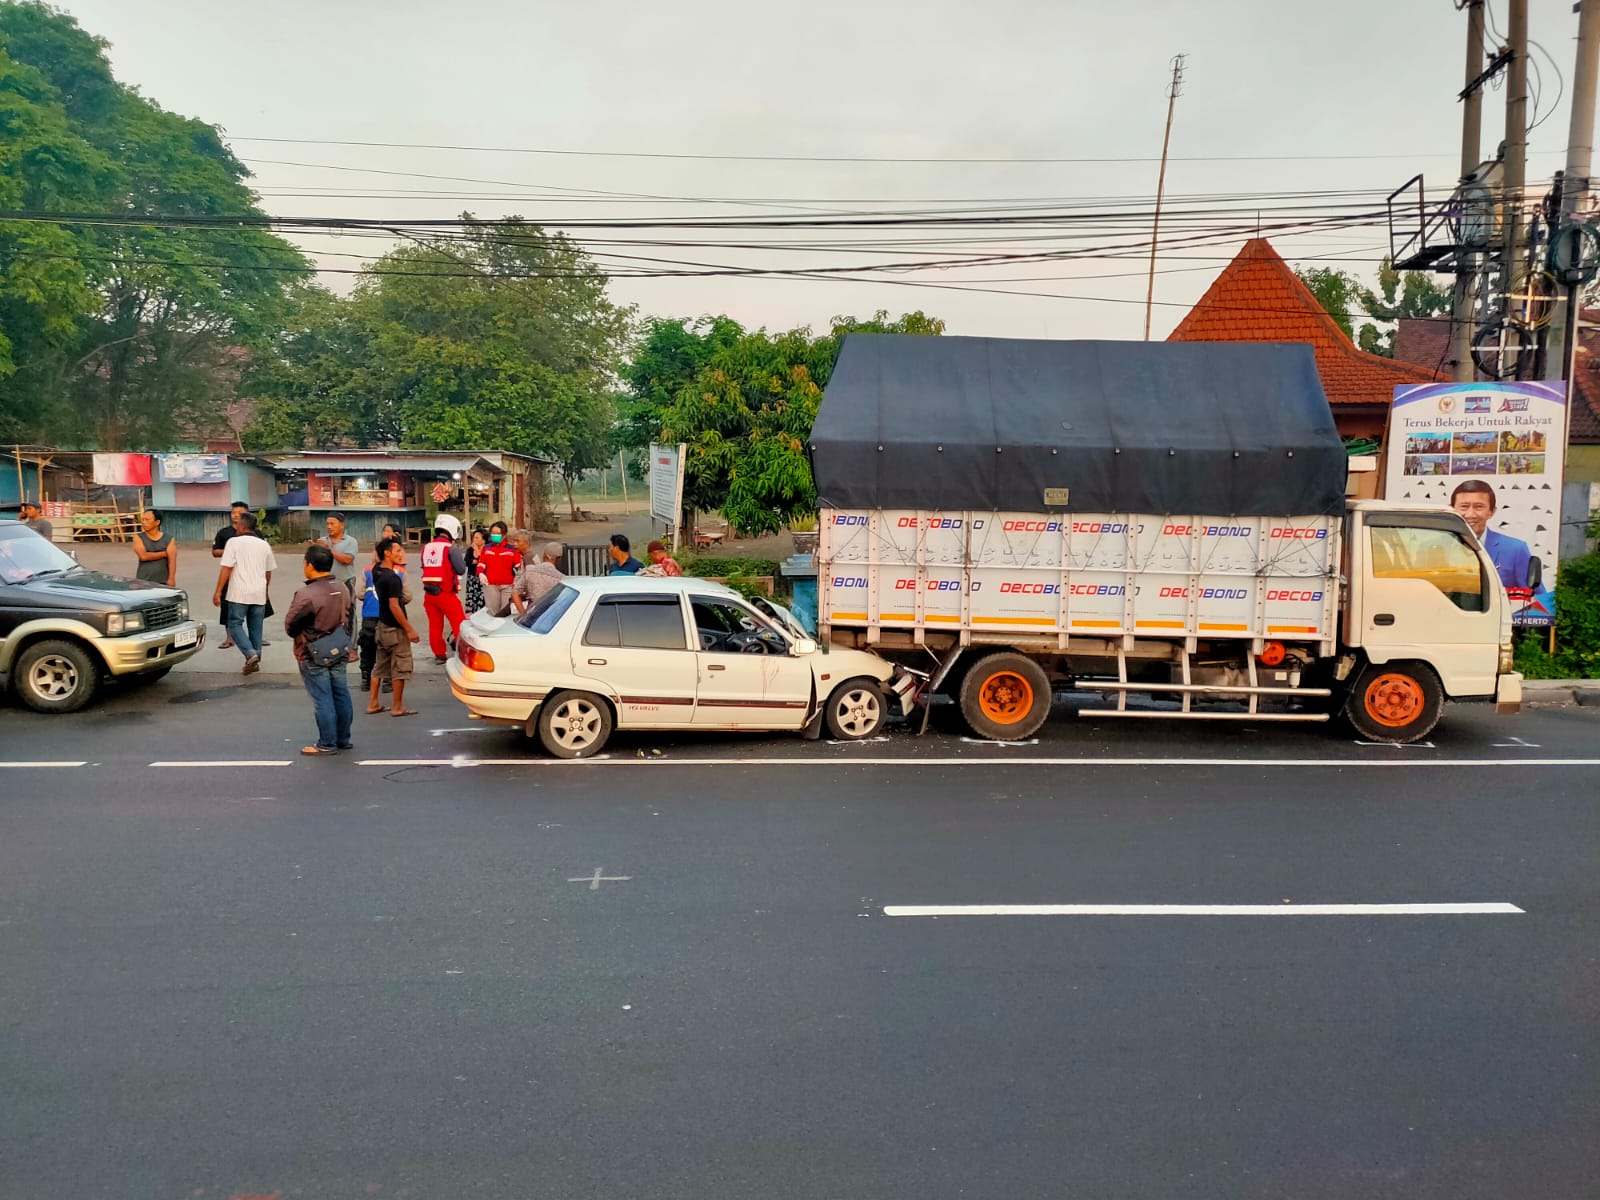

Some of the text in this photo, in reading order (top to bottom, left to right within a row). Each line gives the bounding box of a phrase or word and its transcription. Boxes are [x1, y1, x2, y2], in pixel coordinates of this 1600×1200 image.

[1403, 415, 1553, 429] Terus Bekerja Untuk Rakyat
